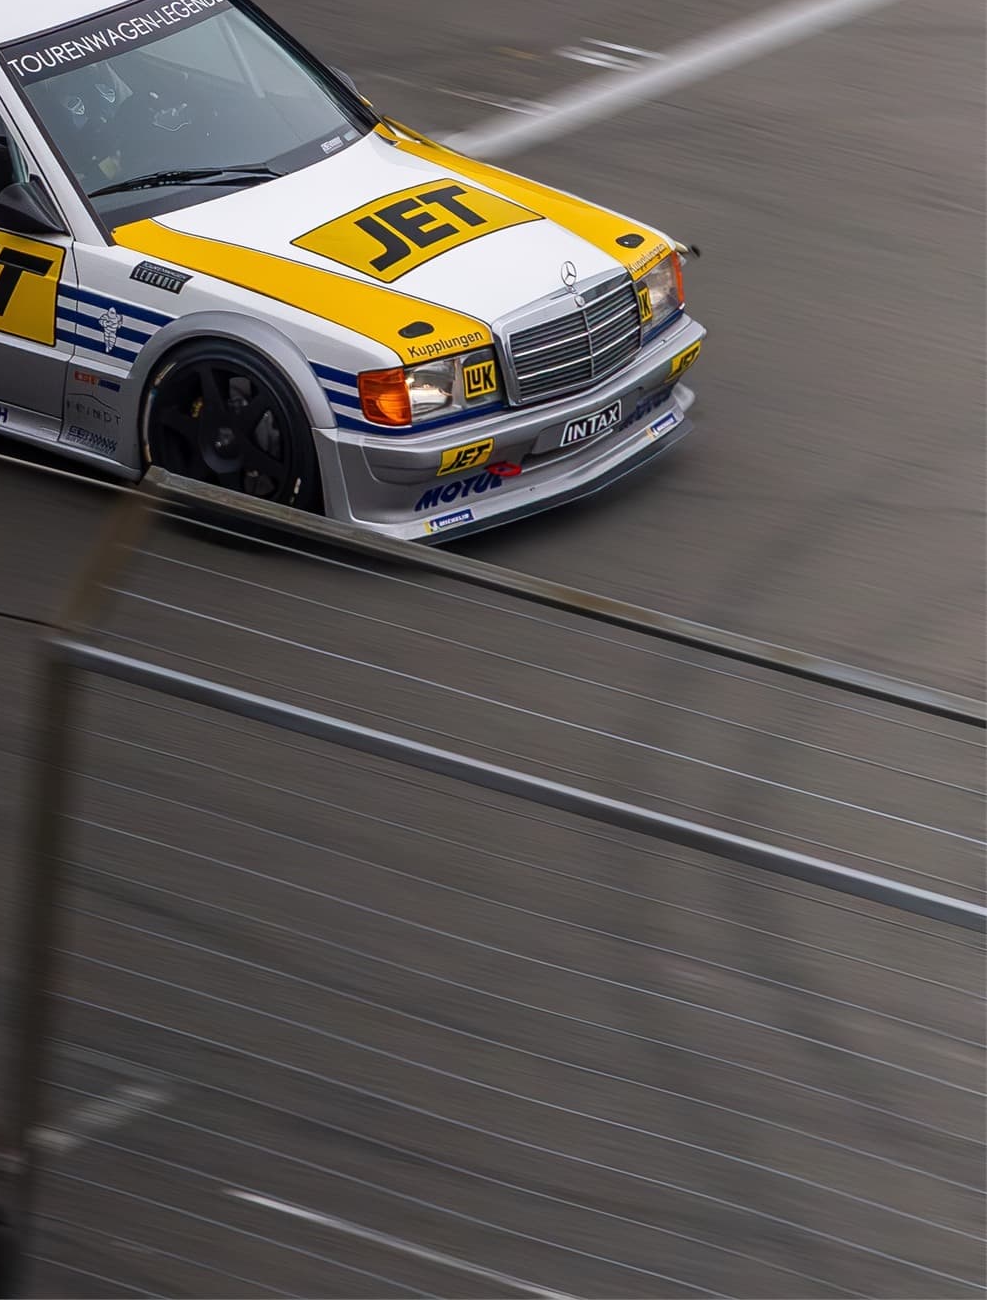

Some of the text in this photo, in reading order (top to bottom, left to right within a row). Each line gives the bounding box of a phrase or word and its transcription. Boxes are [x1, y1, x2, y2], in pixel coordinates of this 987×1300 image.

[354, 185, 488, 272] JET
[407, 331, 484, 358] Kupplungen
[567, 405, 618, 442] INTAX
[439, 443, 491, 474] JET
